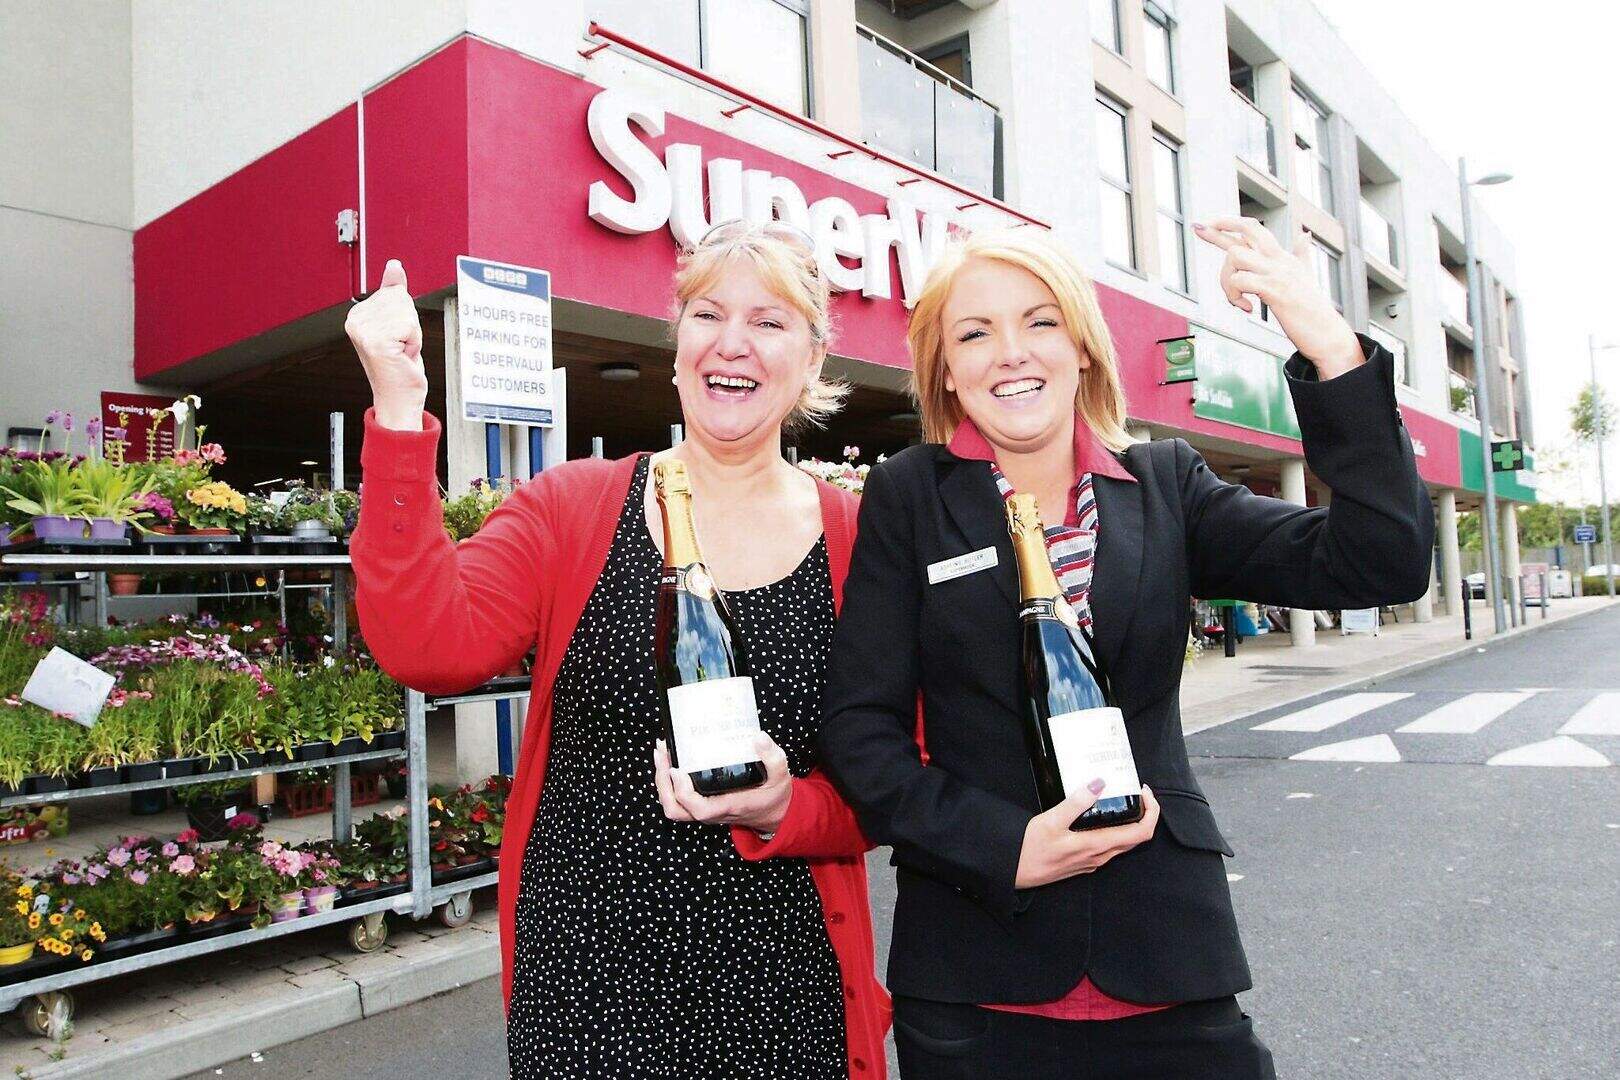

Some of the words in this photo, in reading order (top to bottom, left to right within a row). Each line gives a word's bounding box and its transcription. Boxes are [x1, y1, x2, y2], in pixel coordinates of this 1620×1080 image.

[463, 304, 470, 316] 3
[473, 305, 517, 323] HOURS
[520, 312, 549, 328] FREE
[466, 327, 520, 346] PARKING
[524, 335, 547, 350] FOR
[473, 351, 543, 372] SUPERVALU
[471, 374, 546, 395] CUSTOMERS
[108, 403, 144, 416] Opening
